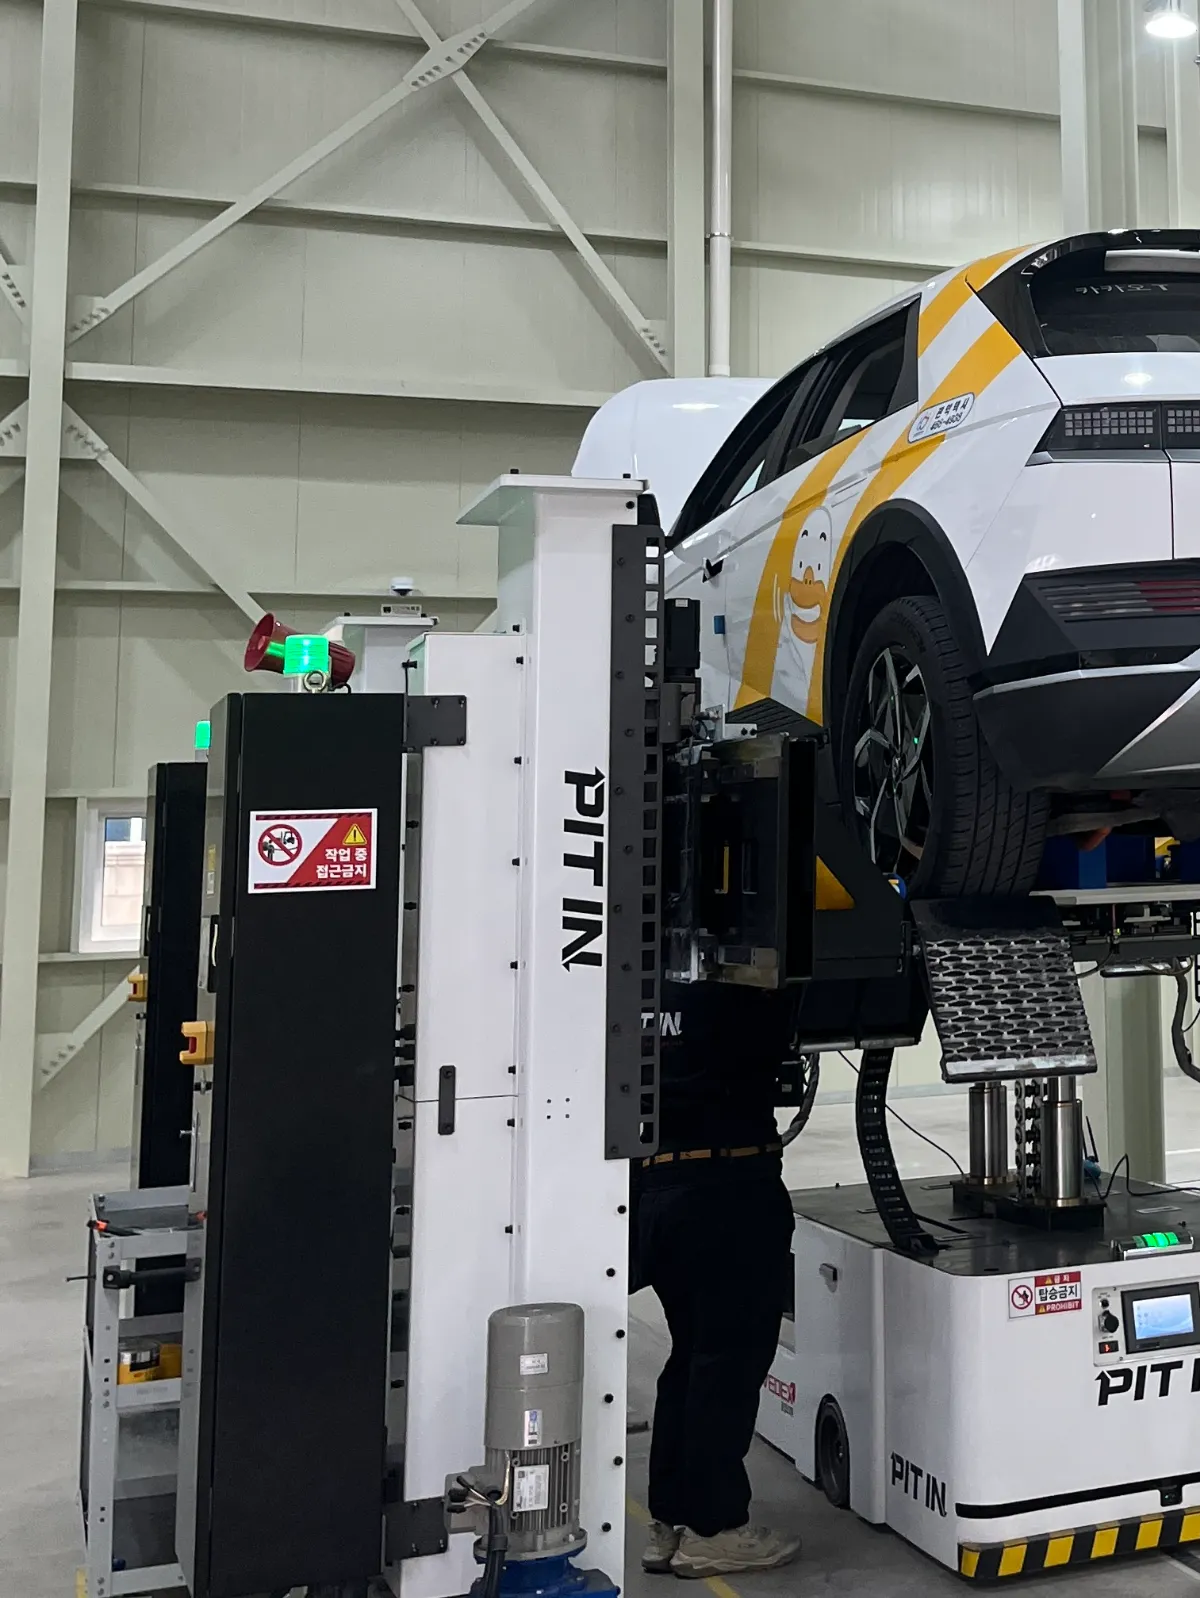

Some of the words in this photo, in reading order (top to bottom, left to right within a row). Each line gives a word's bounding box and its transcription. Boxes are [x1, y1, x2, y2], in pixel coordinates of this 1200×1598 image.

[325, 848, 351, 862] 작업
[354, 847, 368, 862] 중
[316, 864, 367, 879] 접근금지
[1038, 1283, 1078, 1302] 탑승금지
[1046, 1300, 1080, 1312] PROHIBIT
